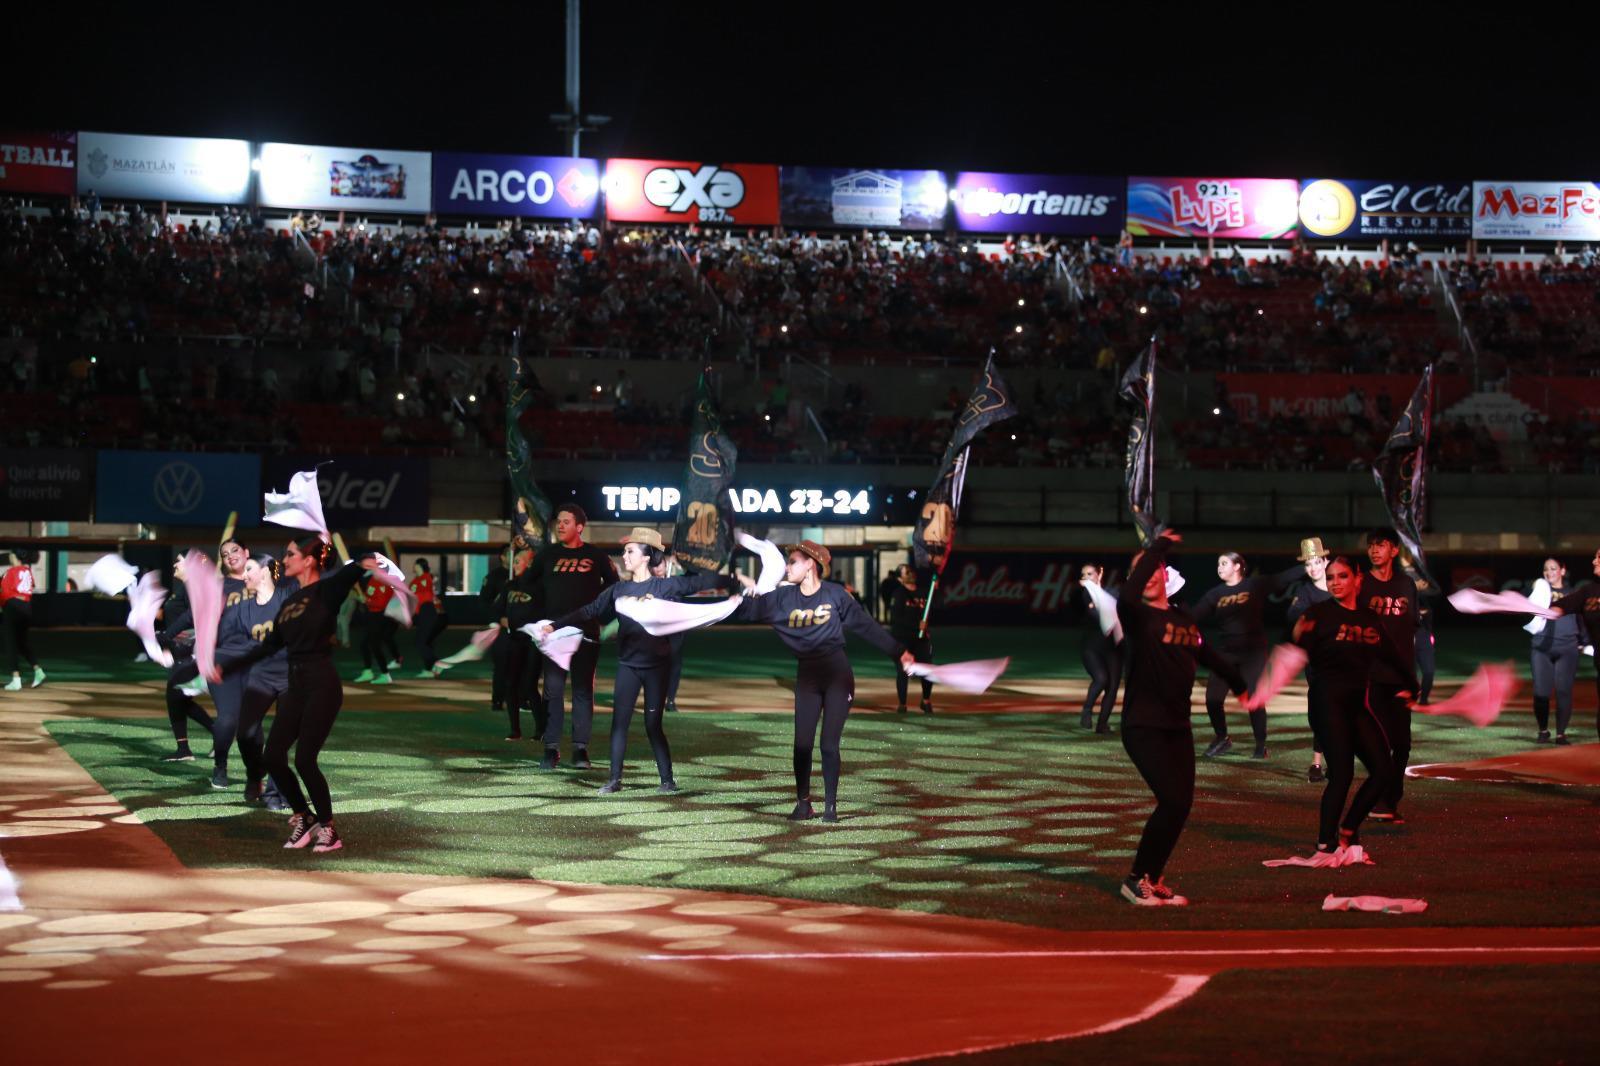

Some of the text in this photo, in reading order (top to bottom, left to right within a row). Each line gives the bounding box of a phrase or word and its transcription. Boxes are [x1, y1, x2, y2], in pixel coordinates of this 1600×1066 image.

[450, 168, 554, 204] ARCO
[1361, 184, 1470, 212] El Cid
[1477, 185, 1600, 222] MazFe
[1361, 215, 1471, 228] RESORTS
[38, 464, 81, 480] alivio
[8, 485, 63, 499] tenerte
[318, 472, 401, 510] elcel
[602, 486, 870, 514] TEMPDA 23-24
[553, 558, 595, 573] ms
[944, 563, 1025, 601] Salsa
[788, 603, 832, 628] ms
